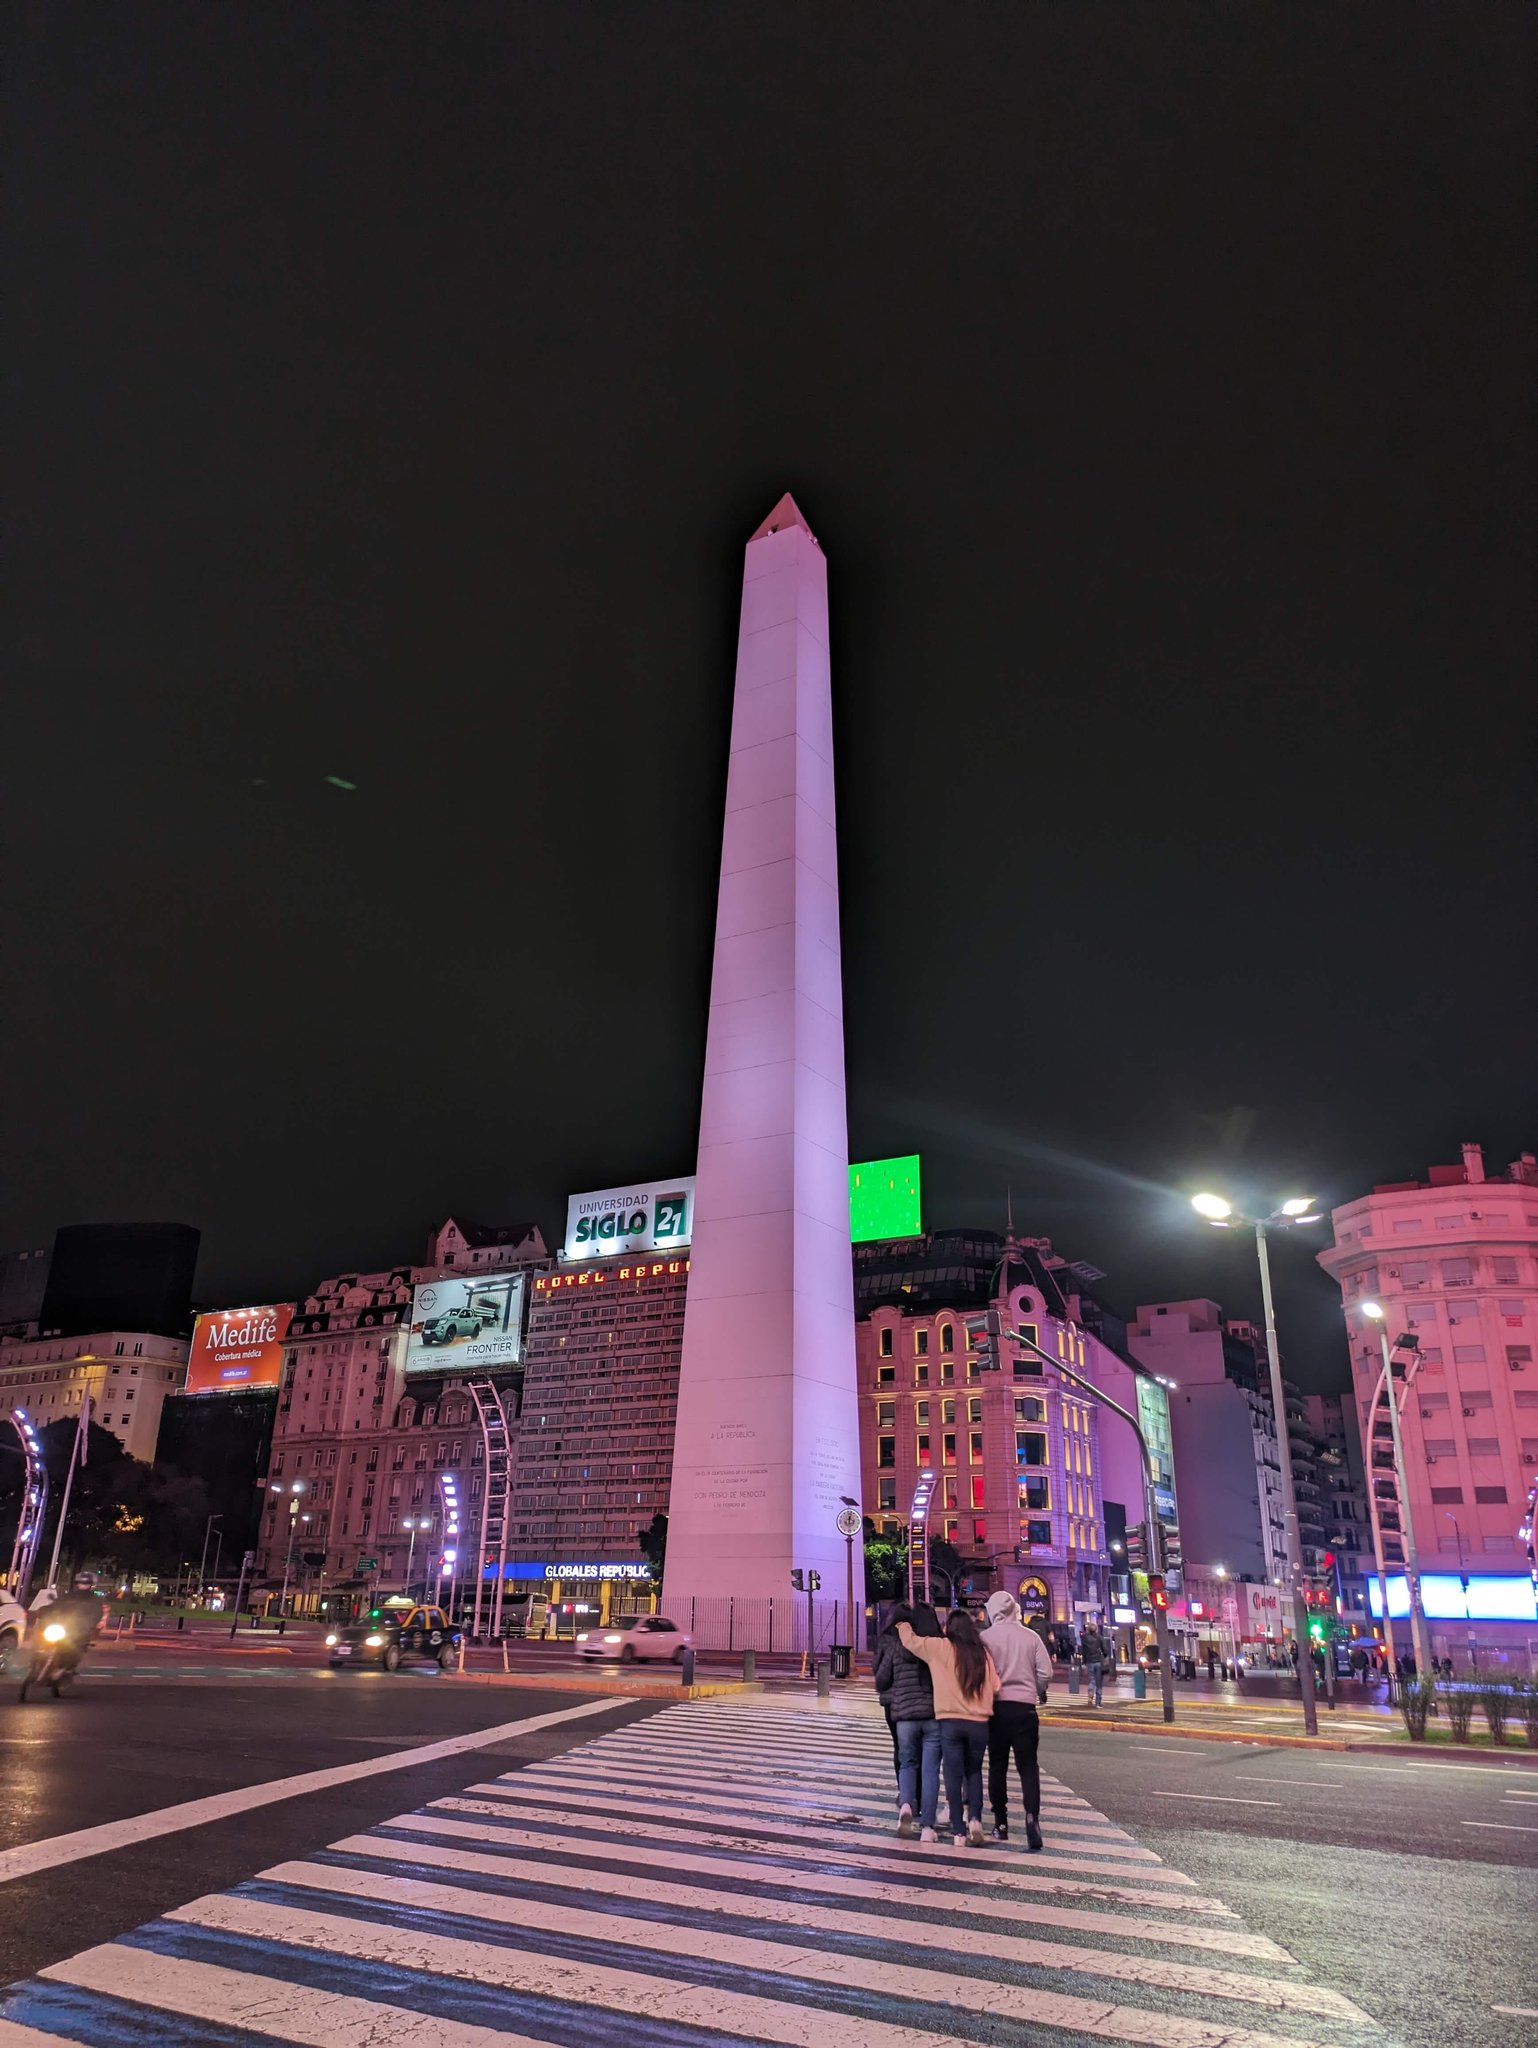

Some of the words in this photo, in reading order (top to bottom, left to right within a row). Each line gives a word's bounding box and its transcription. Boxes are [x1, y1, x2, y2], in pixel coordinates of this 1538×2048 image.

[579, 1194, 649, 1214] UNIVERSIDAD
[575, 1208, 648, 1242] SIGLO
[657, 1206, 682, 1236] 21
[536, 1272, 604, 1289] HOTEL
[619, 1261, 691, 1280] REPU
[205, 1317, 277, 1349] Medifé
[493, 1335, 513, 1343] NISSAN
[214, 1352, 241, 1362] Cobertura
[242, 1349, 262, 1359] médica
[466, 1342, 512, 1355] FRONTIER
[545, 1564, 598, 1578] GLOBALES
[599, 1564, 651, 1578] REPÚBLIC
[1026, 1600, 1044, 1608] BBVA
